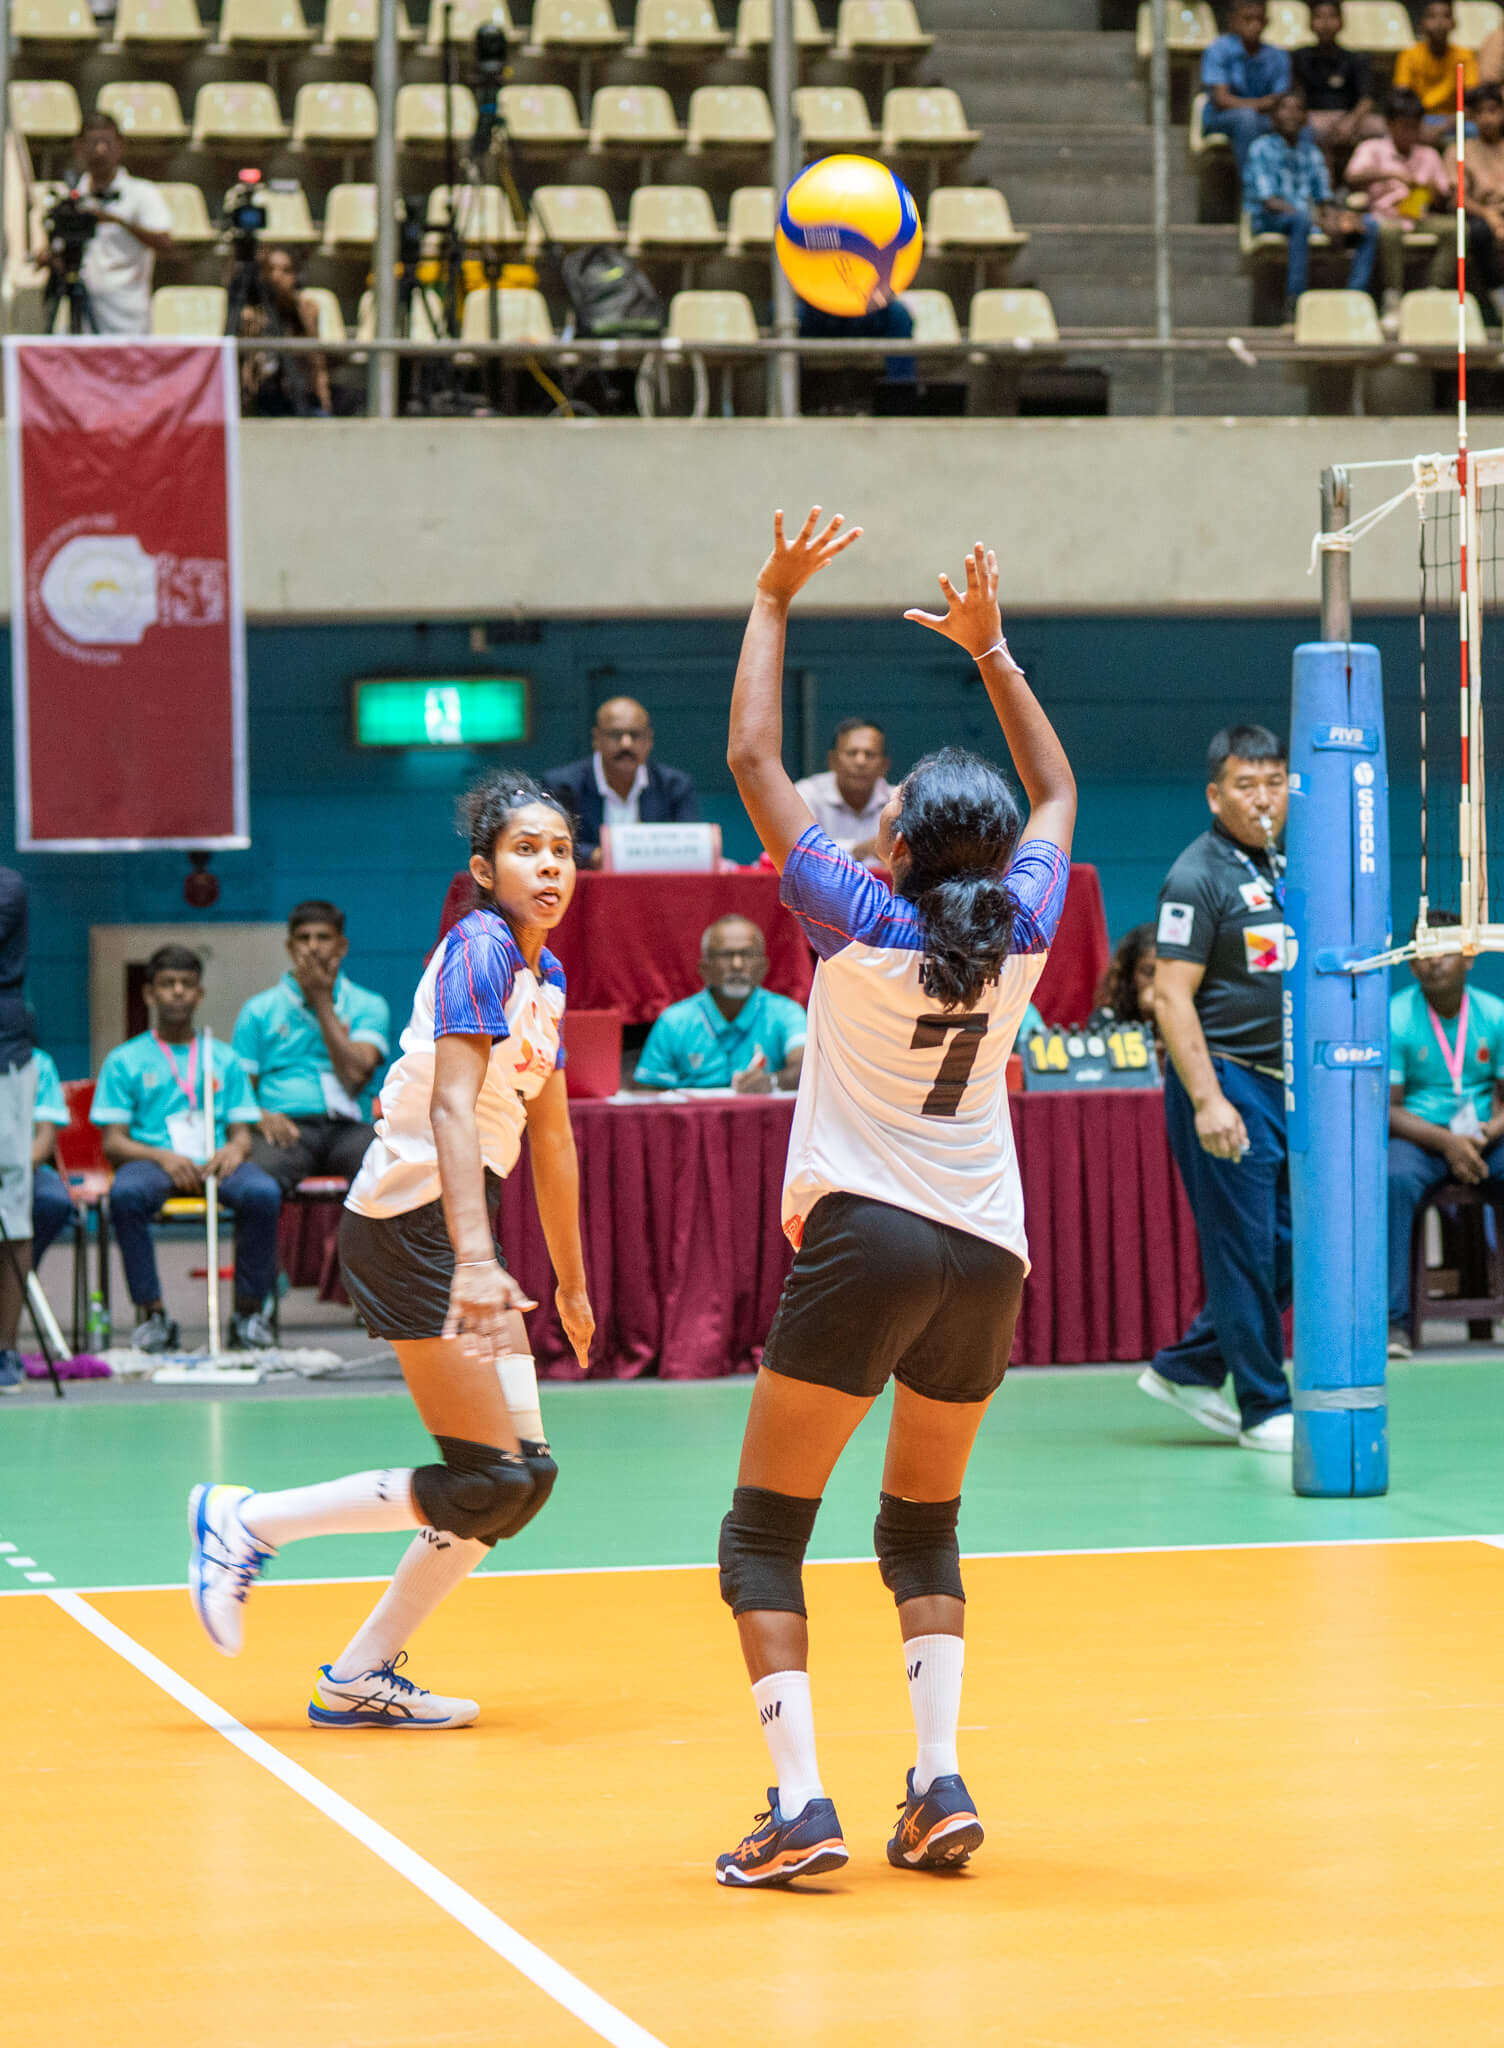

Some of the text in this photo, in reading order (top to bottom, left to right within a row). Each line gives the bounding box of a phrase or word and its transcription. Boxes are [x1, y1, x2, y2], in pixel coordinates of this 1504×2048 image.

[1329, 726, 1363, 742] FIVB
[910, 1012, 989, 1117] 7
[1029, 1035, 1069, 1070] 14
[1108, 1032, 1147, 1068] 15
